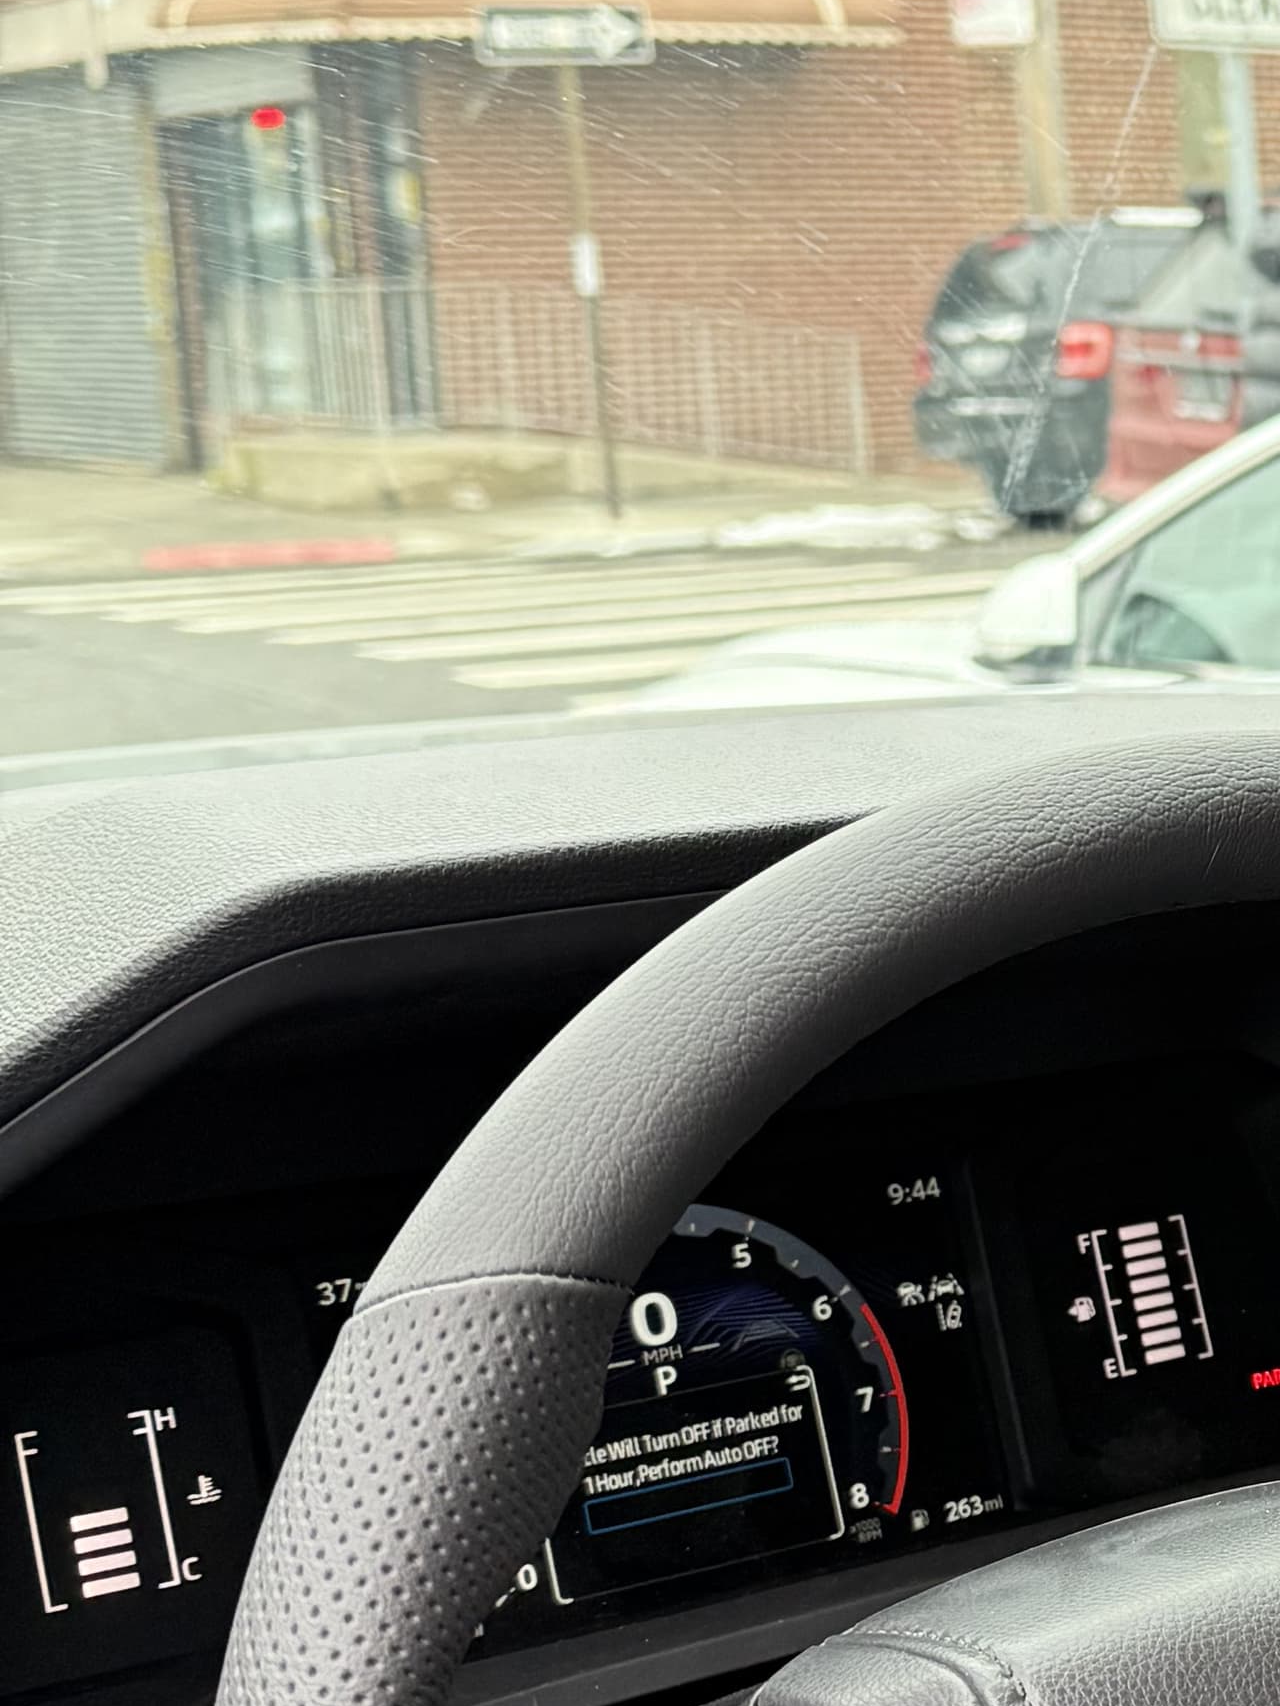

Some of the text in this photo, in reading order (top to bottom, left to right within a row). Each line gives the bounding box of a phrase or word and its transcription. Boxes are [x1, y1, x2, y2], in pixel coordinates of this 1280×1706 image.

[887, 1177, 941, 1205] 9:44
[731, 1243, 752, 1269] 5
[1077, 1233, 1091, 1255] F
[630, 1292, 678, 1347] 0
[811, 1296, 833, 1321] 6
[642, 1344, 684, 1367] MPH
[1103, 1358, 1119, 1379] E
[654, 1365, 677, 1395] P
[855, 1386, 874, 1413] 7
[154, 1407, 177, 1431] H
[608, 1441, 642, 1462] Will
[642, 1432, 681, 1453] Turn
[681, 1421, 711, 1445] OFF
[711, 1419, 723, 1438] if
[725, 1406, 780, 1436] Parked
[780, 1403, 804, 1424] for
[704, 1445, 744, 1469] Auto
[744, 1435, 779, 1459] OFF?
[850, 1482, 870, 1510] 8
[181, 1556, 203, 1581] C
[517, 1563, 538, 1590] 0
